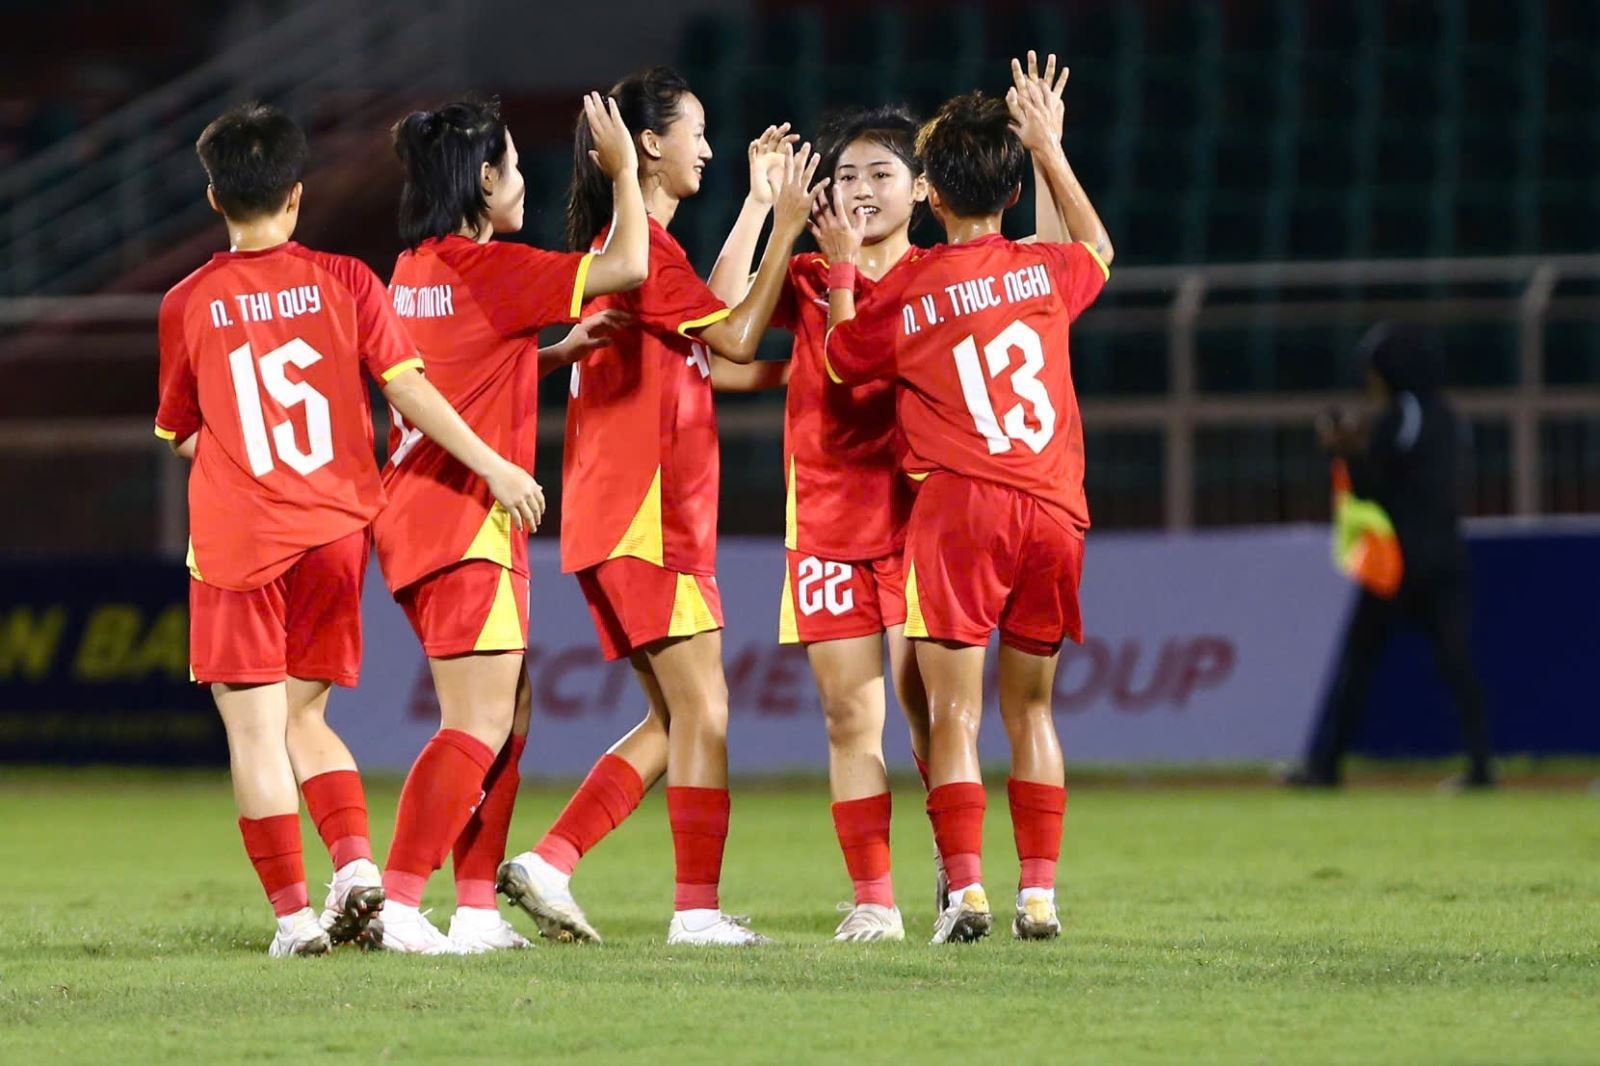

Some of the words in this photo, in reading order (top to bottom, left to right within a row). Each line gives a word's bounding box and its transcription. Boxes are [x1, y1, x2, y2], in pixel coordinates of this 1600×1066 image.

[210, 299, 234, 328] N.
[235, 292, 274, 322] THI
[277, 285, 322, 319] QUY
[417, 284, 455, 318] MINH
[902, 303, 921, 336] N.
[921, 294, 945, 326] V.
[945, 275, 1002, 317] THUC
[1003, 263, 1052, 303] NGHI
[228, 337, 335, 478] 15
[952, 319, 1057, 456] 13
[798, 555, 854, 617] 22
